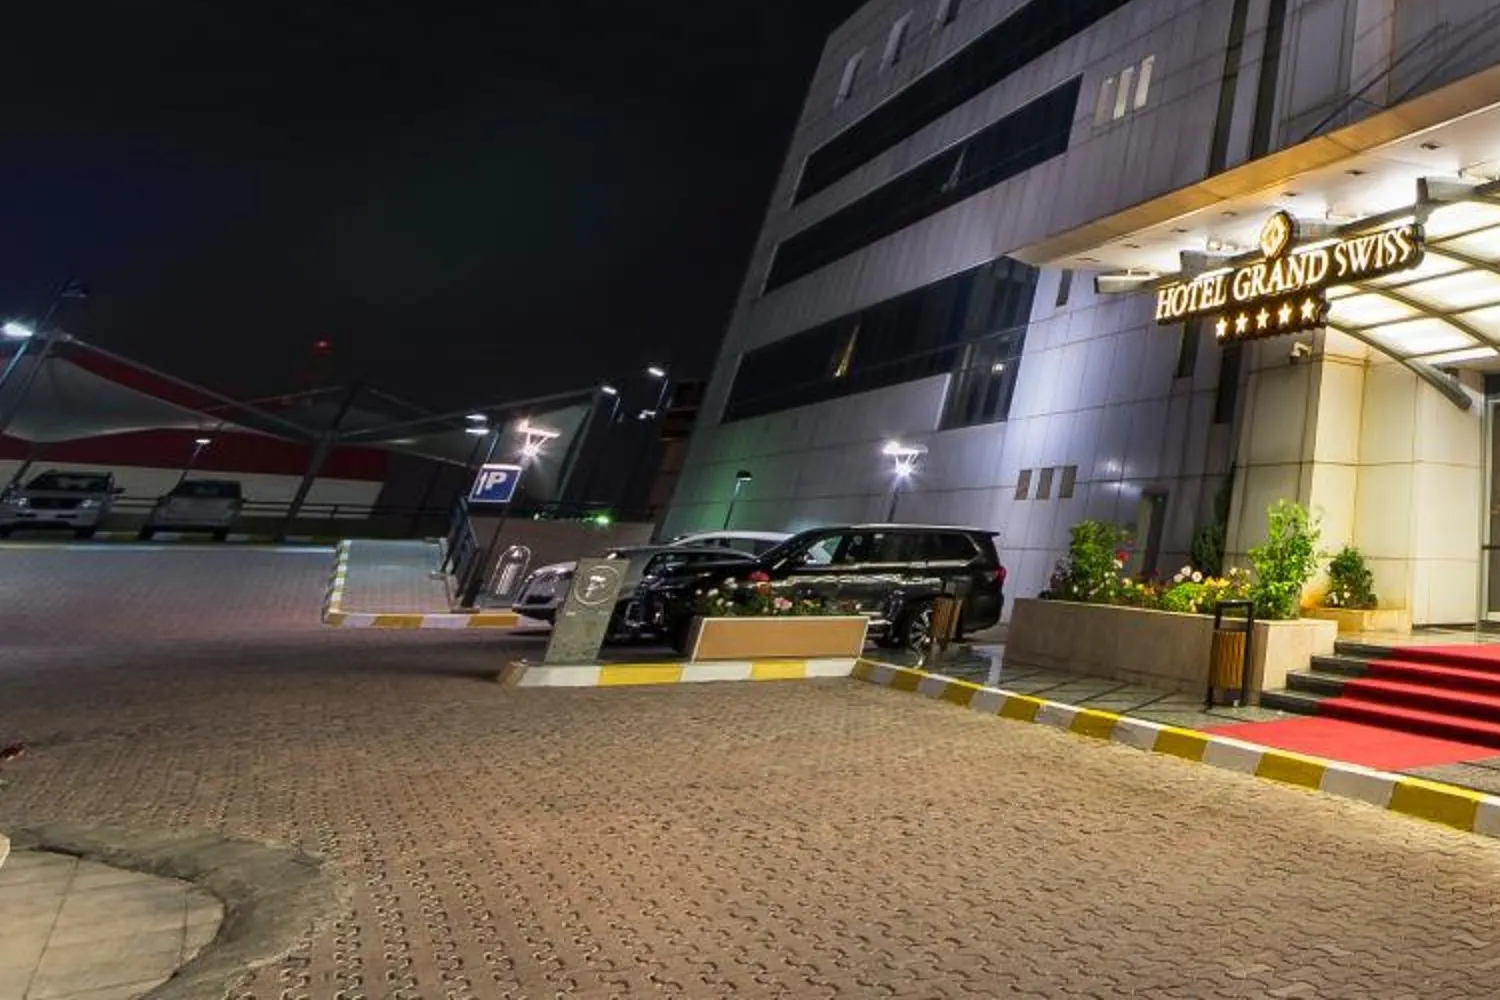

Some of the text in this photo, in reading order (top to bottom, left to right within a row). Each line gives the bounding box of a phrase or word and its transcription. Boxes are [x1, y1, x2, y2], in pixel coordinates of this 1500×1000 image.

[1155, 225, 1412, 319] HOTEL GRAND SWISS
